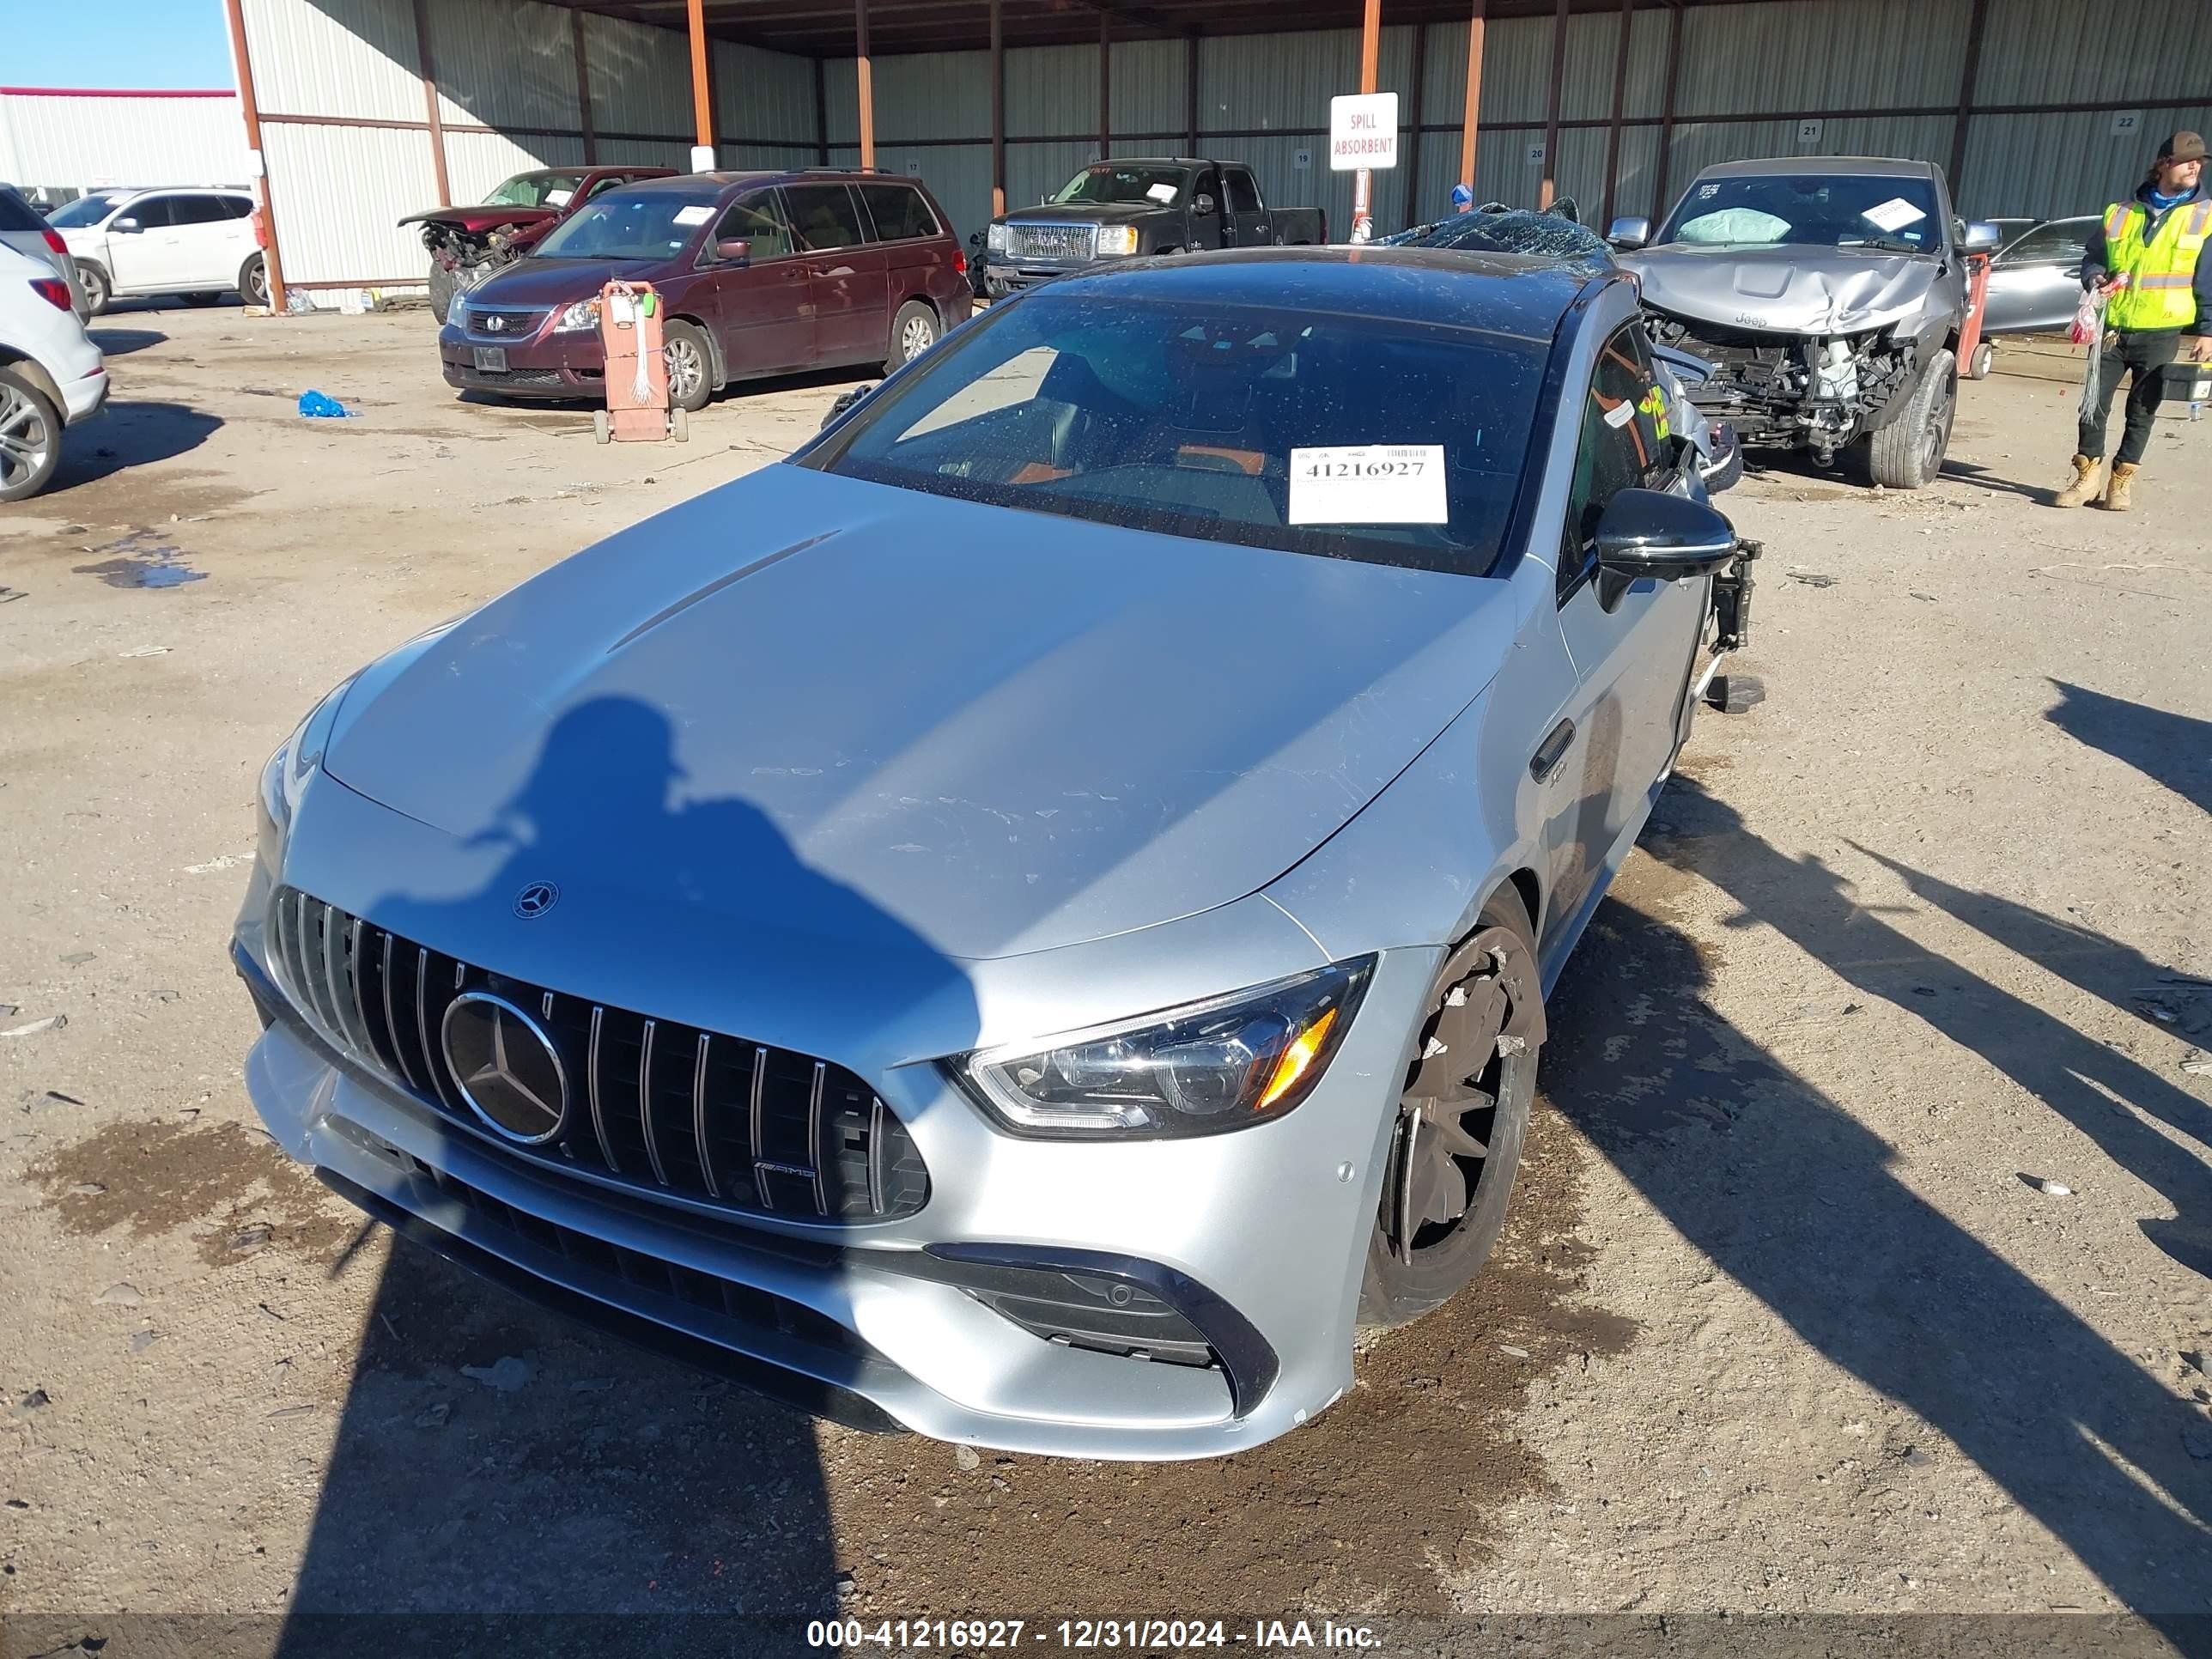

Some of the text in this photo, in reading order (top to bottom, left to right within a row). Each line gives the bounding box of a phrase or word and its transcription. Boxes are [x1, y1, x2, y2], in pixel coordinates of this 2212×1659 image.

[1351, 113, 1376, 130] SPILL
[2118, 118, 2134, 127] 22
[1803, 126, 1816, 136] 21
[1334, 137, 1394, 155] ABSORBENT
[1532, 149, 1542, 158] 20
[1030, 234, 1066, 246] GMC
[1735, 312, 1767, 328] Jeep
[1306, 462, 1425, 477] 41216927
